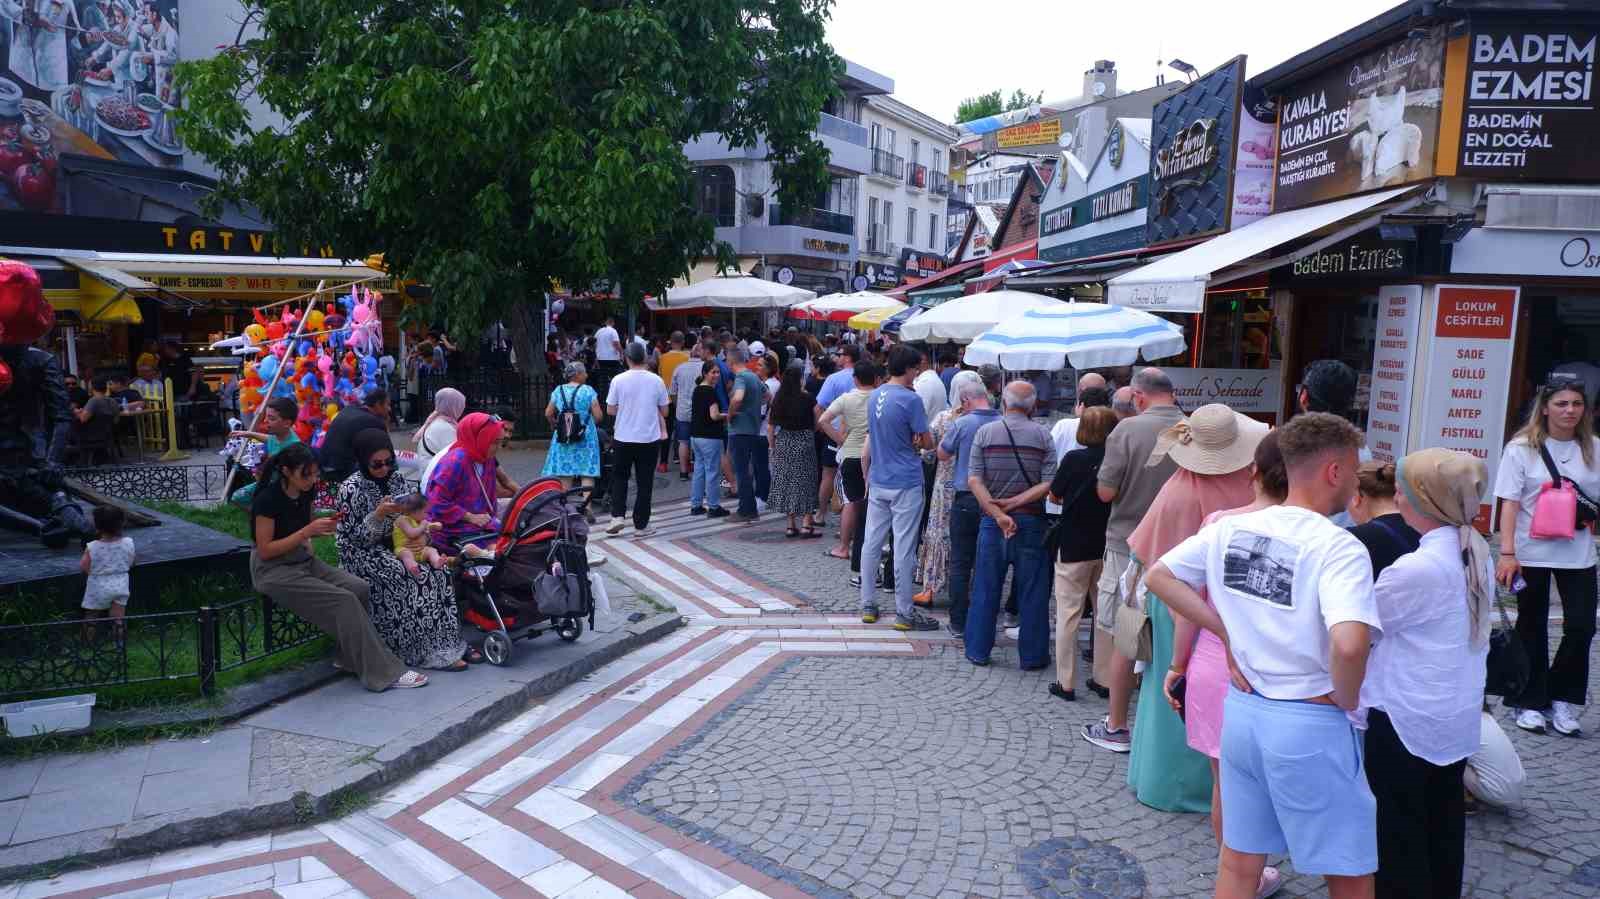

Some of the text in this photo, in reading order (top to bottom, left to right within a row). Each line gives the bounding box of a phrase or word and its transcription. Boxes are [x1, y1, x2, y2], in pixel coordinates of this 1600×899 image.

[1474, 34, 1597, 63] BADEM
[1470, 64, 1593, 100] EZMESİ
[1282, 89, 1327, 124] KAVALA
[1280, 101, 1351, 150] KURABİYESİ
[1468, 112, 1543, 128] BADEMİN
[1465, 130, 1553, 148] EN DOĞAL
[1463, 149, 1526, 167] LEZZETİ
[1560, 237, 1600, 268] Os
[1455, 301, 1497, 312] LOKUM
[1456, 348, 1485, 360] SADE
[1452, 367, 1486, 380] GÜLLÜ
[1208, 376, 1268, 398] Şehzade
[1451, 388, 1483, 400] NARLI
[1447, 408, 1482, 419] ANTEP
[1441, 427, 1484, 439] FISTIKLI
